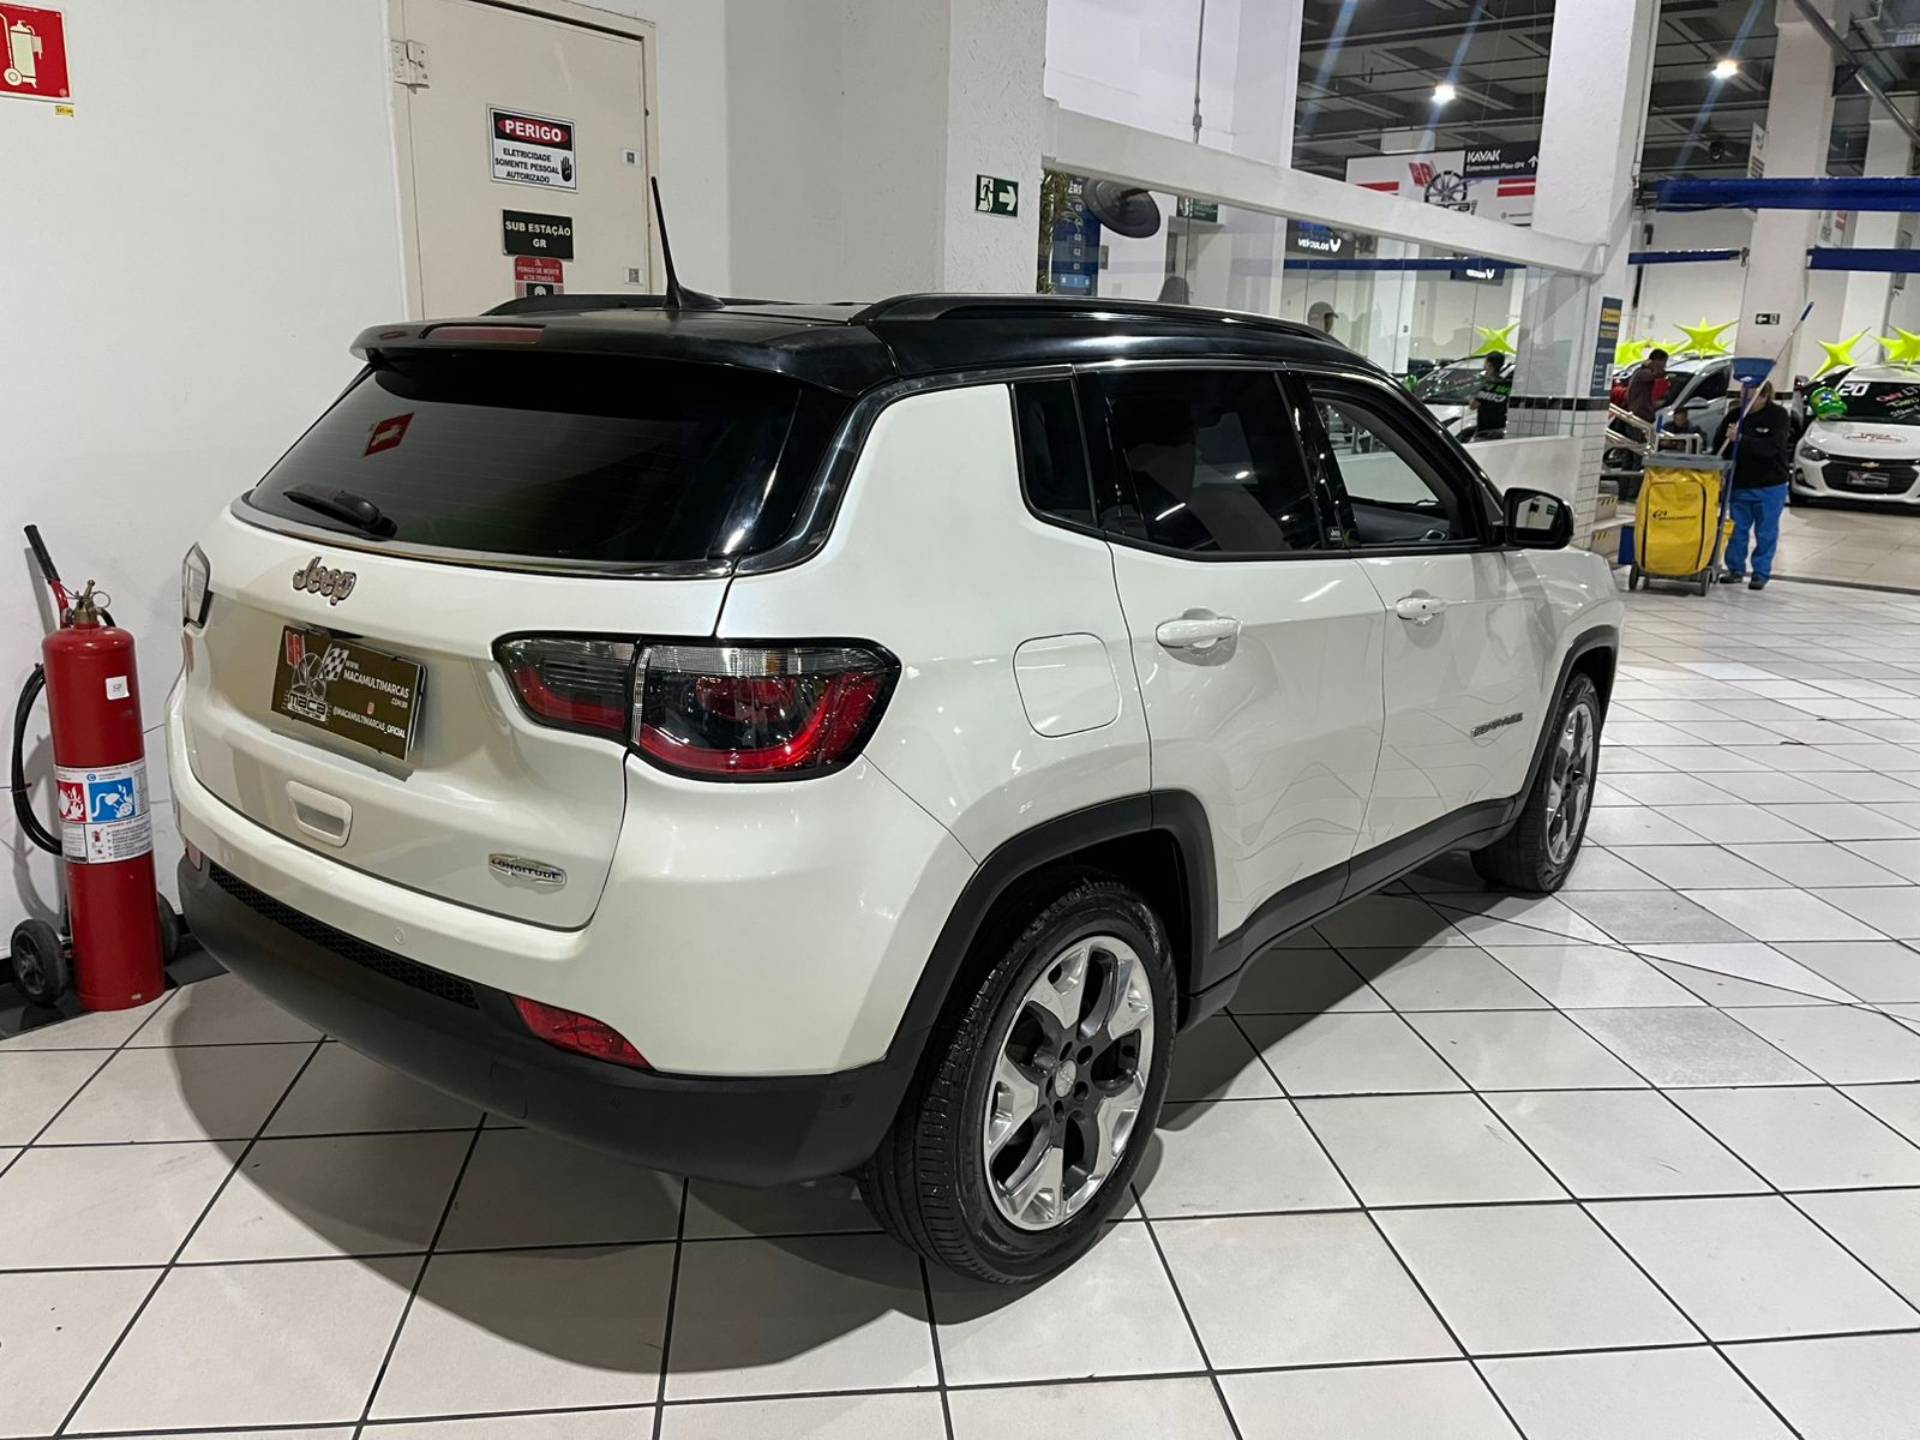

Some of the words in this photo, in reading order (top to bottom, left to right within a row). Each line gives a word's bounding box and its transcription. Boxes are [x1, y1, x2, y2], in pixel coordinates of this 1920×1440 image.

[504, 120, 562, 142] PERIGO
[503, 148, 552, 162] ELETRICIDADE
[1467, 149, 1501, 163] KAVAK
[495, 157, 529, 171] SOMENTE
[529, 162, 560, 175] PESSOAL
[506, 170, 551, 184] AUTORIZADO
[505, 221, 527, 232] SUB
[528, 223, 571, 237] ESTAÇÃO
[532, 238, 547, 248] GR
[1839, 383, 1871, 396] 20
[293, 556, 357, 606] Jeep
[343, 669, 410, 699] MACAMULTIMARCAS
[492, 858, 561, 879] LONGITUDE
